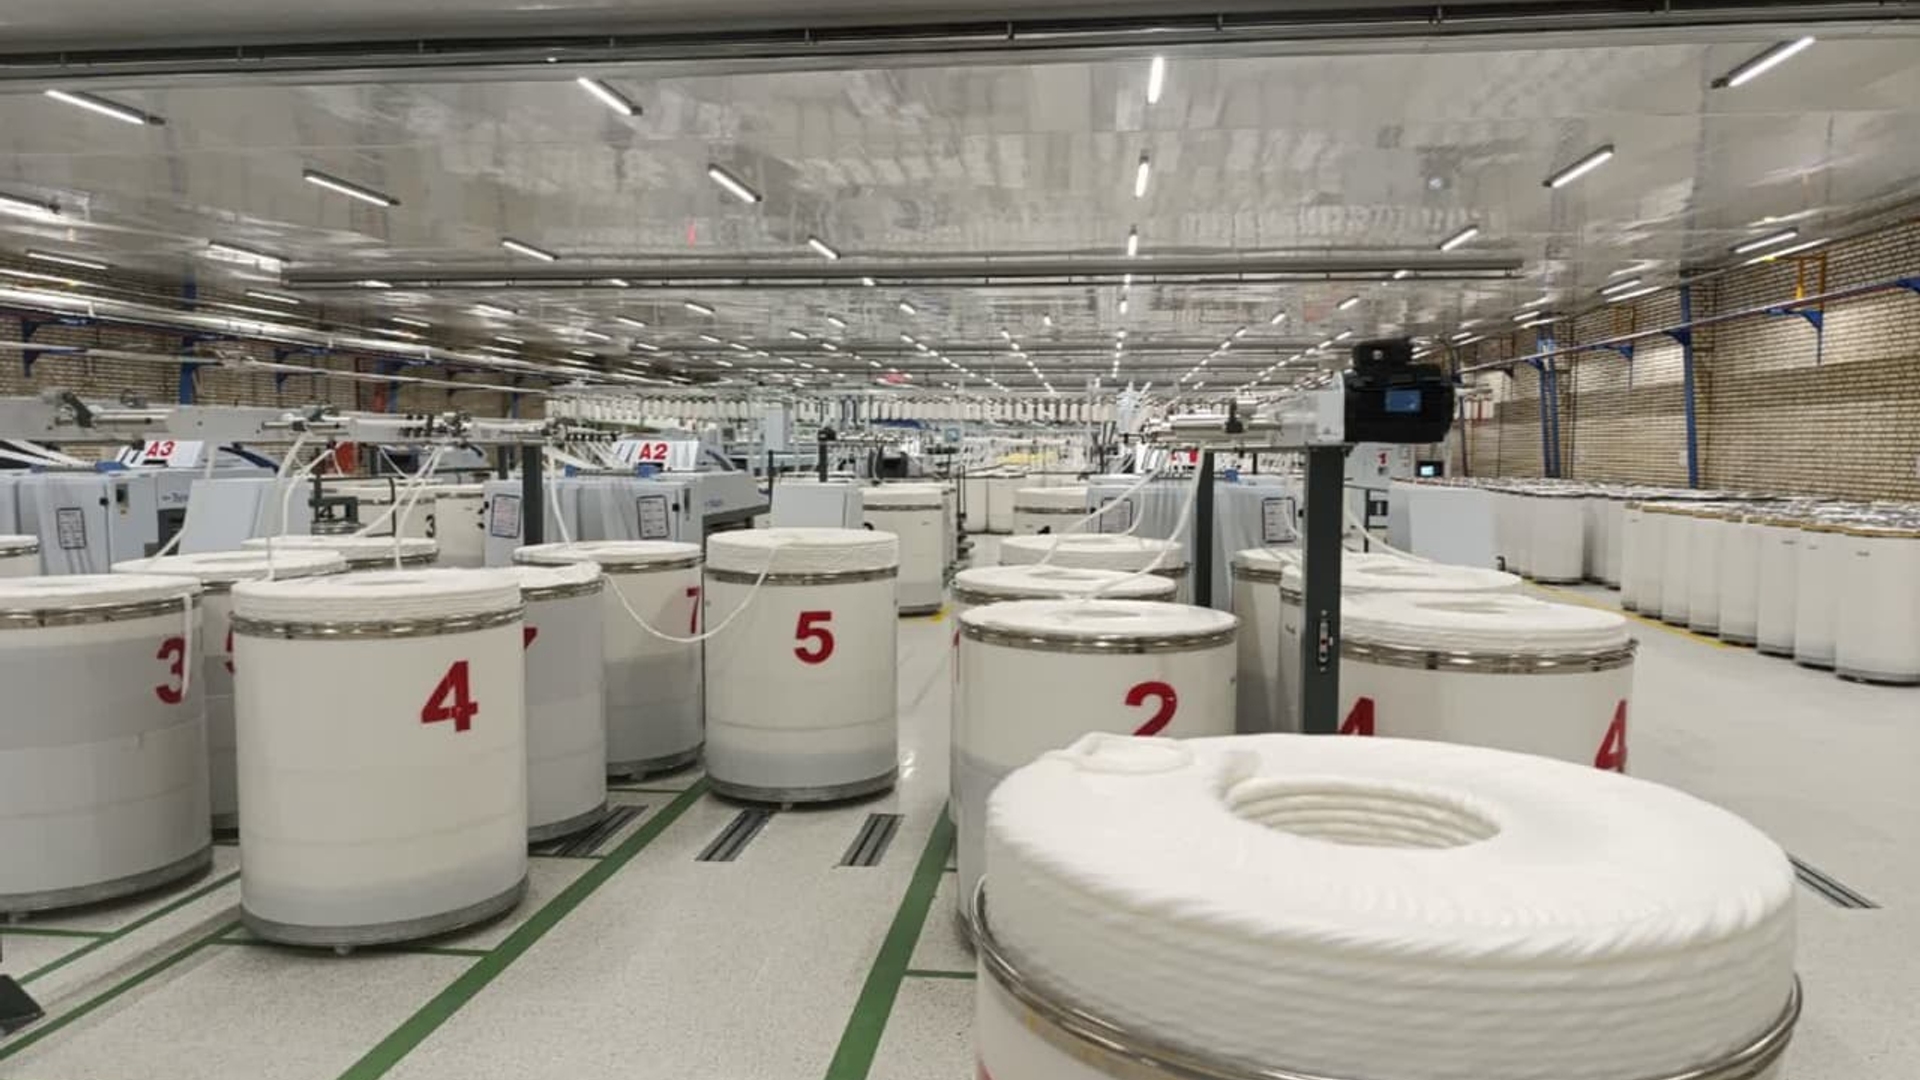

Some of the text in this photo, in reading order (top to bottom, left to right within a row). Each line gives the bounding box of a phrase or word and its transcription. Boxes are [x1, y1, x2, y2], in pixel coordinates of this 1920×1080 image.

[146, 440, 176, 457] A3
[638, 443, 668, 460] A2
[794, 610, 834, 664] 5
[156, 636, 188, 704] 3
[421, 660, 478, 732] 4
[1125, 681, 1177, 736] 2
[1594, 699, 1627, 774] 4
